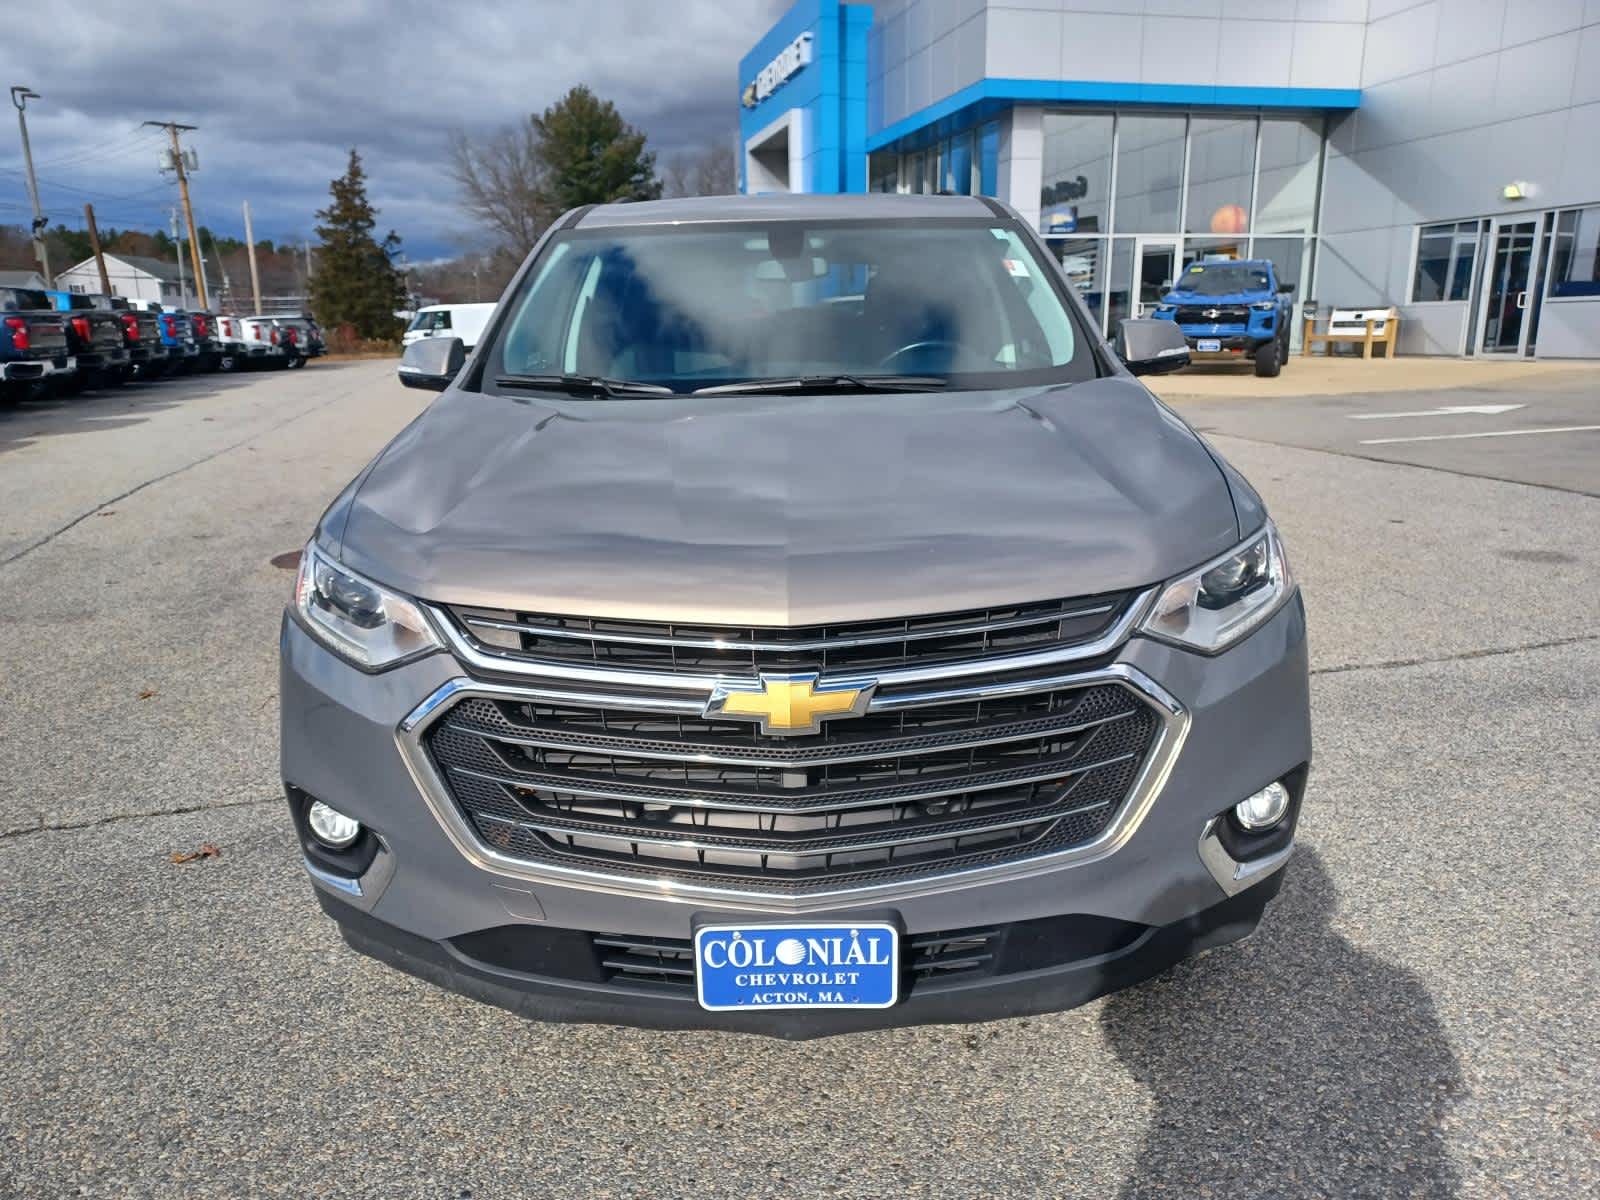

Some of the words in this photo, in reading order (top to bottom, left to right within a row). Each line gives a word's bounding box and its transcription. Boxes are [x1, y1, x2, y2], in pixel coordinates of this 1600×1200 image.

[735, 972, 860, 987] CHEVROLET
[751, 992, 813, 1004] ACTON,
[818, 992, 845, 1003] MA
